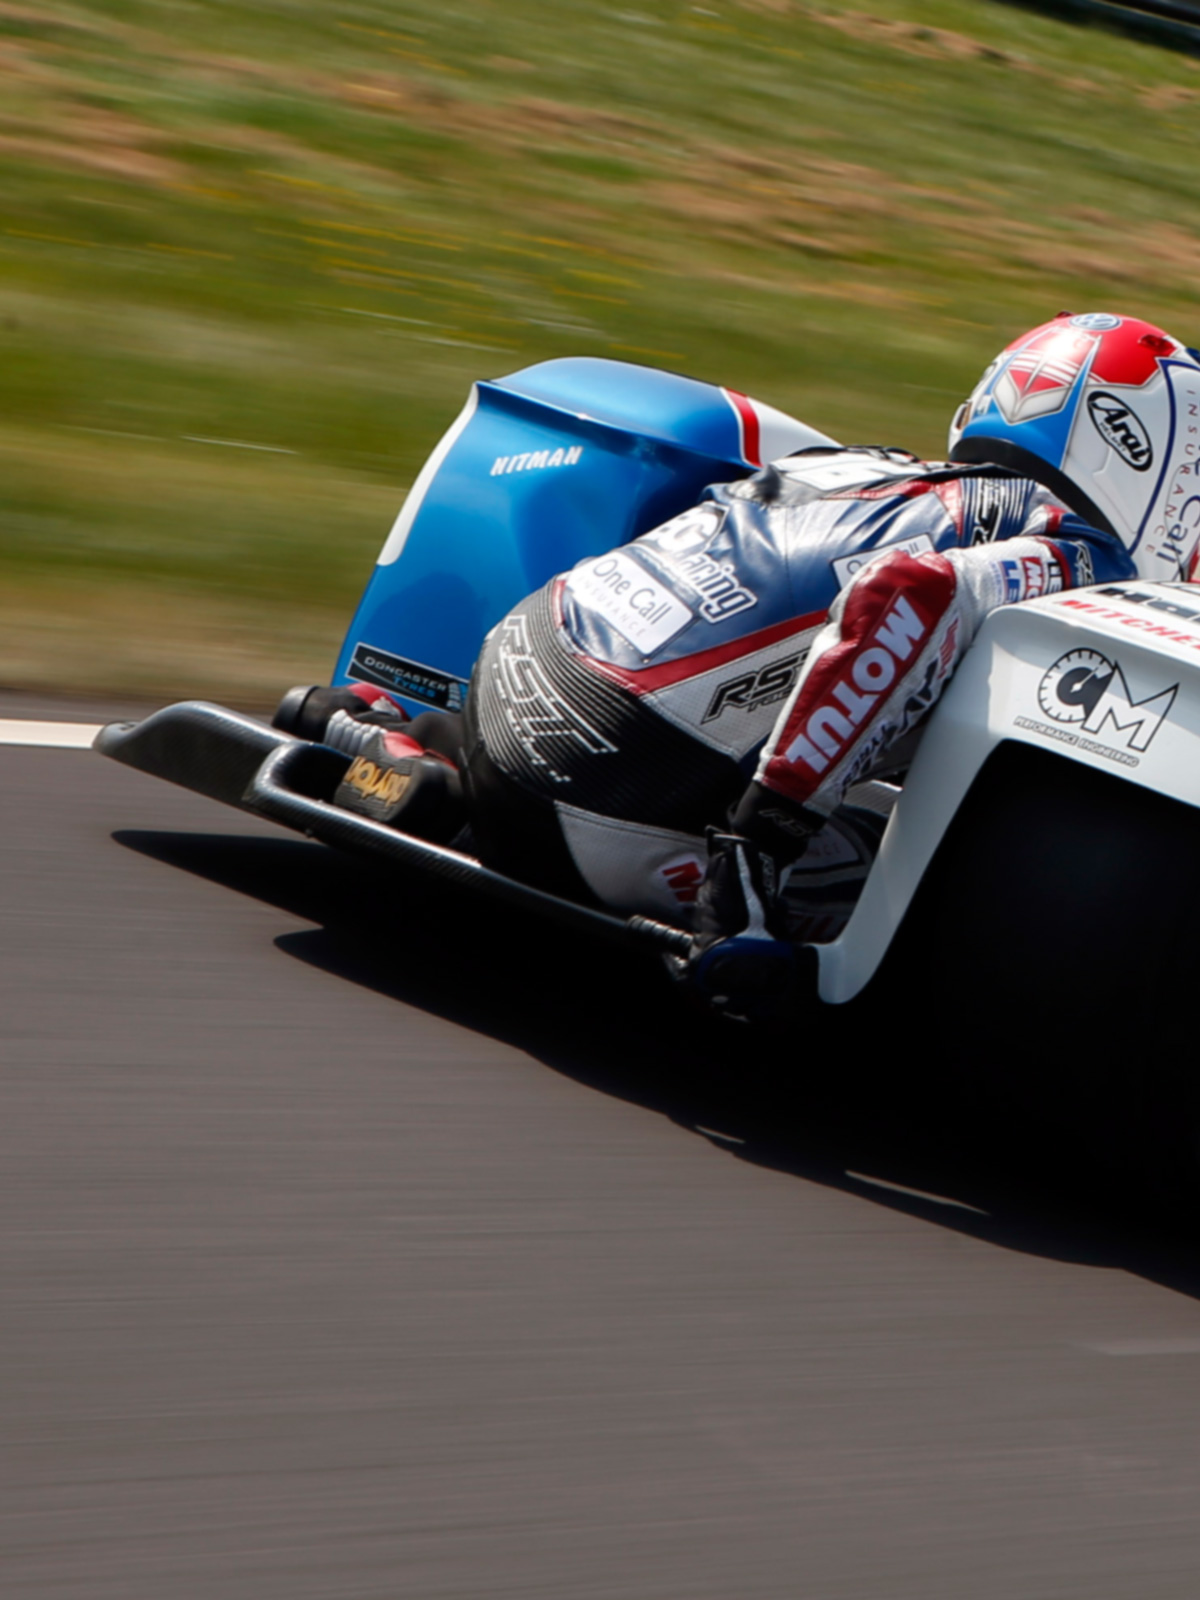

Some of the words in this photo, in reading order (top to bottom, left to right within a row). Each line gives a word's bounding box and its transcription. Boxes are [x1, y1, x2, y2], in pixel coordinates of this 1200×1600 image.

[1090, 401, 1150, 464] Arai
[1145, 389, 1198, 553] INSURANCE
[592, 557, 631, 595] One
[629, 587, 673, 626] Call
[364, 655, 447, 692] DONCASTER
[393, 675, 436, 698] TYRES
[784, 595, 926, 774] MOTUL
[1013, 715, 1079, 746] PERFORMANCE
[1077, 738, 1140, 768] ENGINEERING
